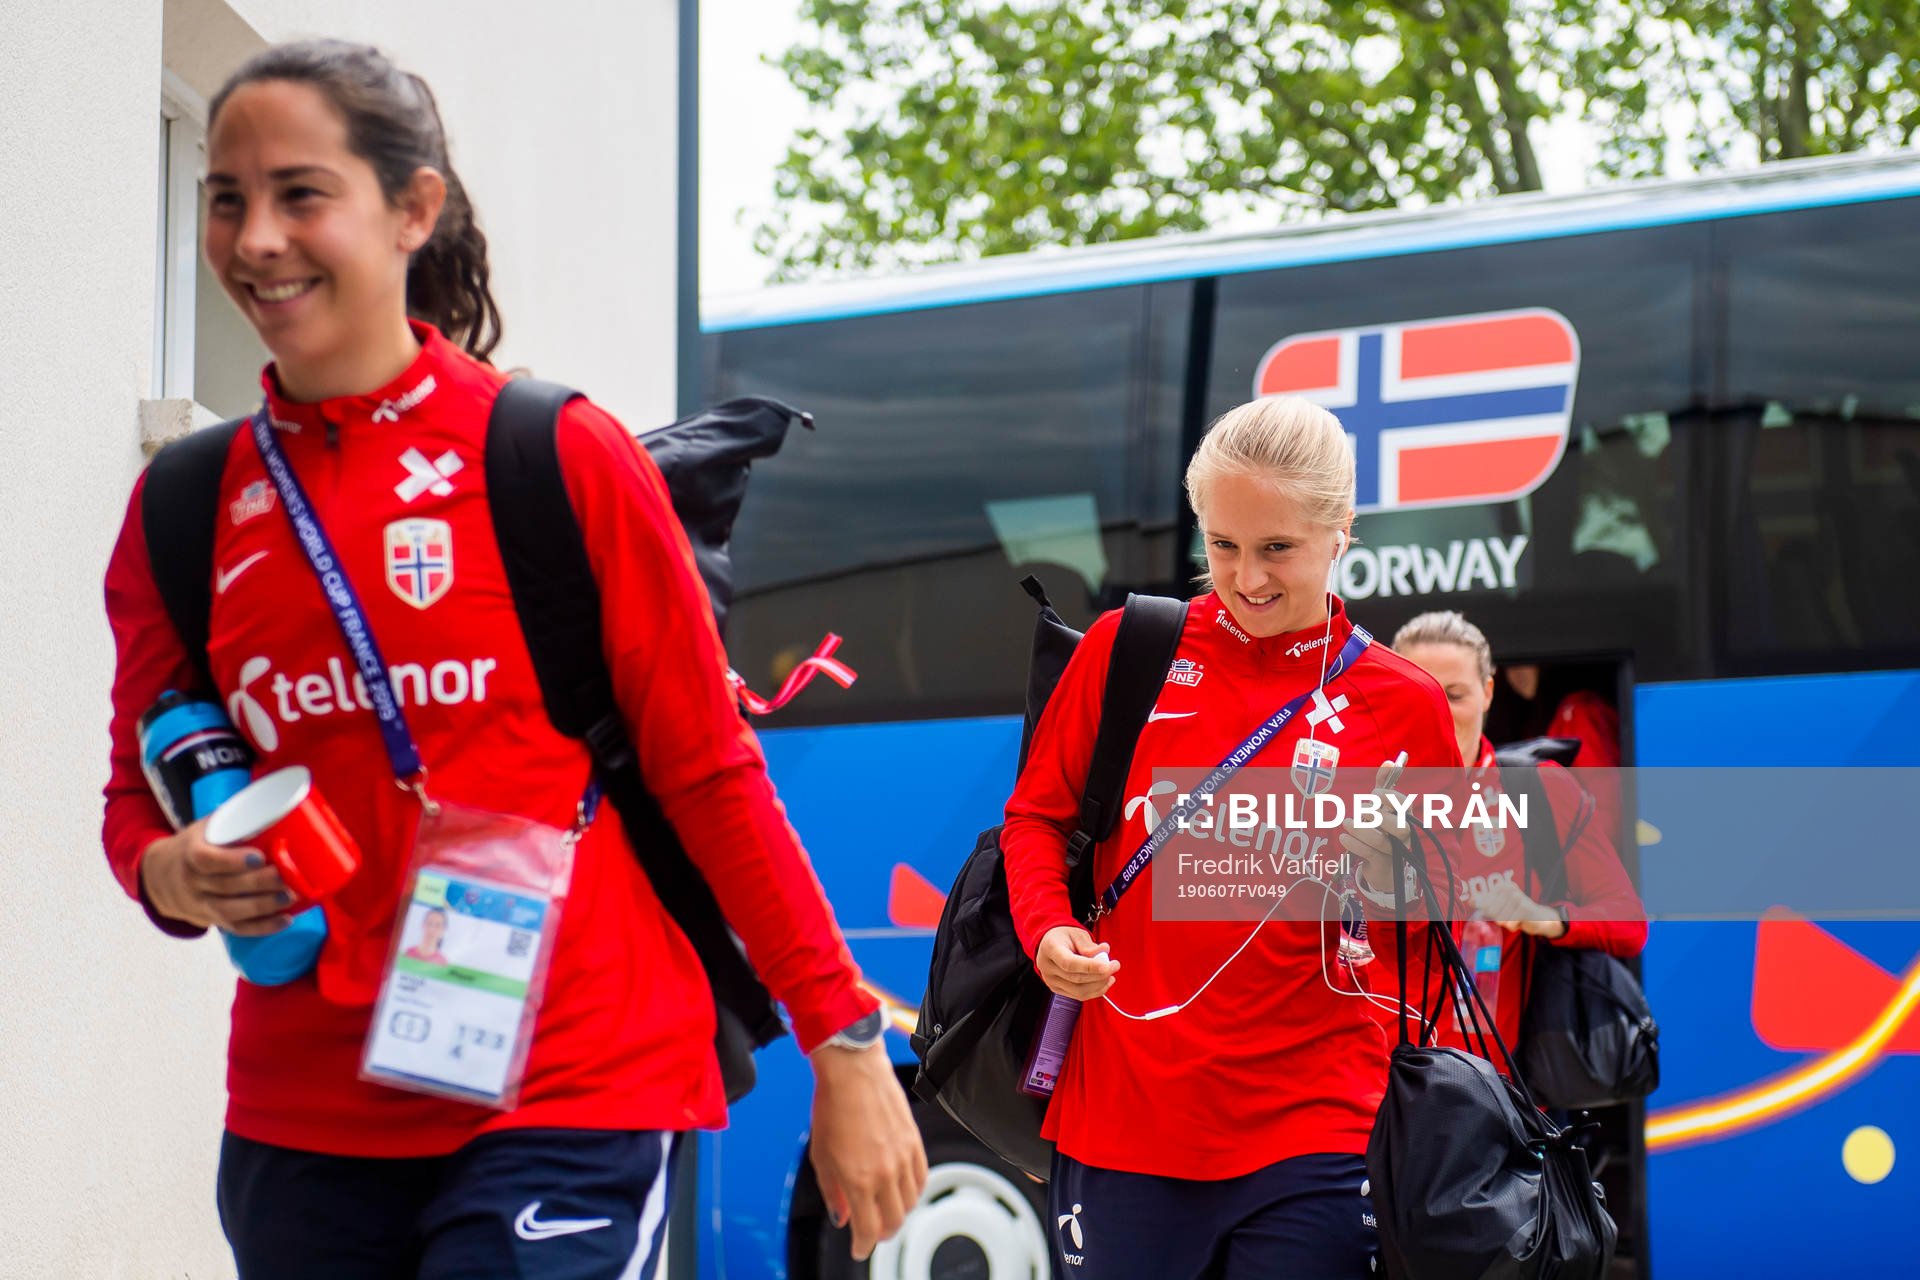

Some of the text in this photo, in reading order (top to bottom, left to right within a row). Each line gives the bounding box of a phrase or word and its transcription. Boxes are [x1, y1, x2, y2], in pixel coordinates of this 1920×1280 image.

[293, 511, 333, 571] WORLD
[322, 570, 351, 607] CUP
[339, 607, 382, 681] FRANCE
[1220, 615, 1251, 645] telenor
[1300, 634, 1334, 653] telenor
[1122, 708, 1292, 882] FIFA WOMEN'S WORLD CUP FRANCE 2019
